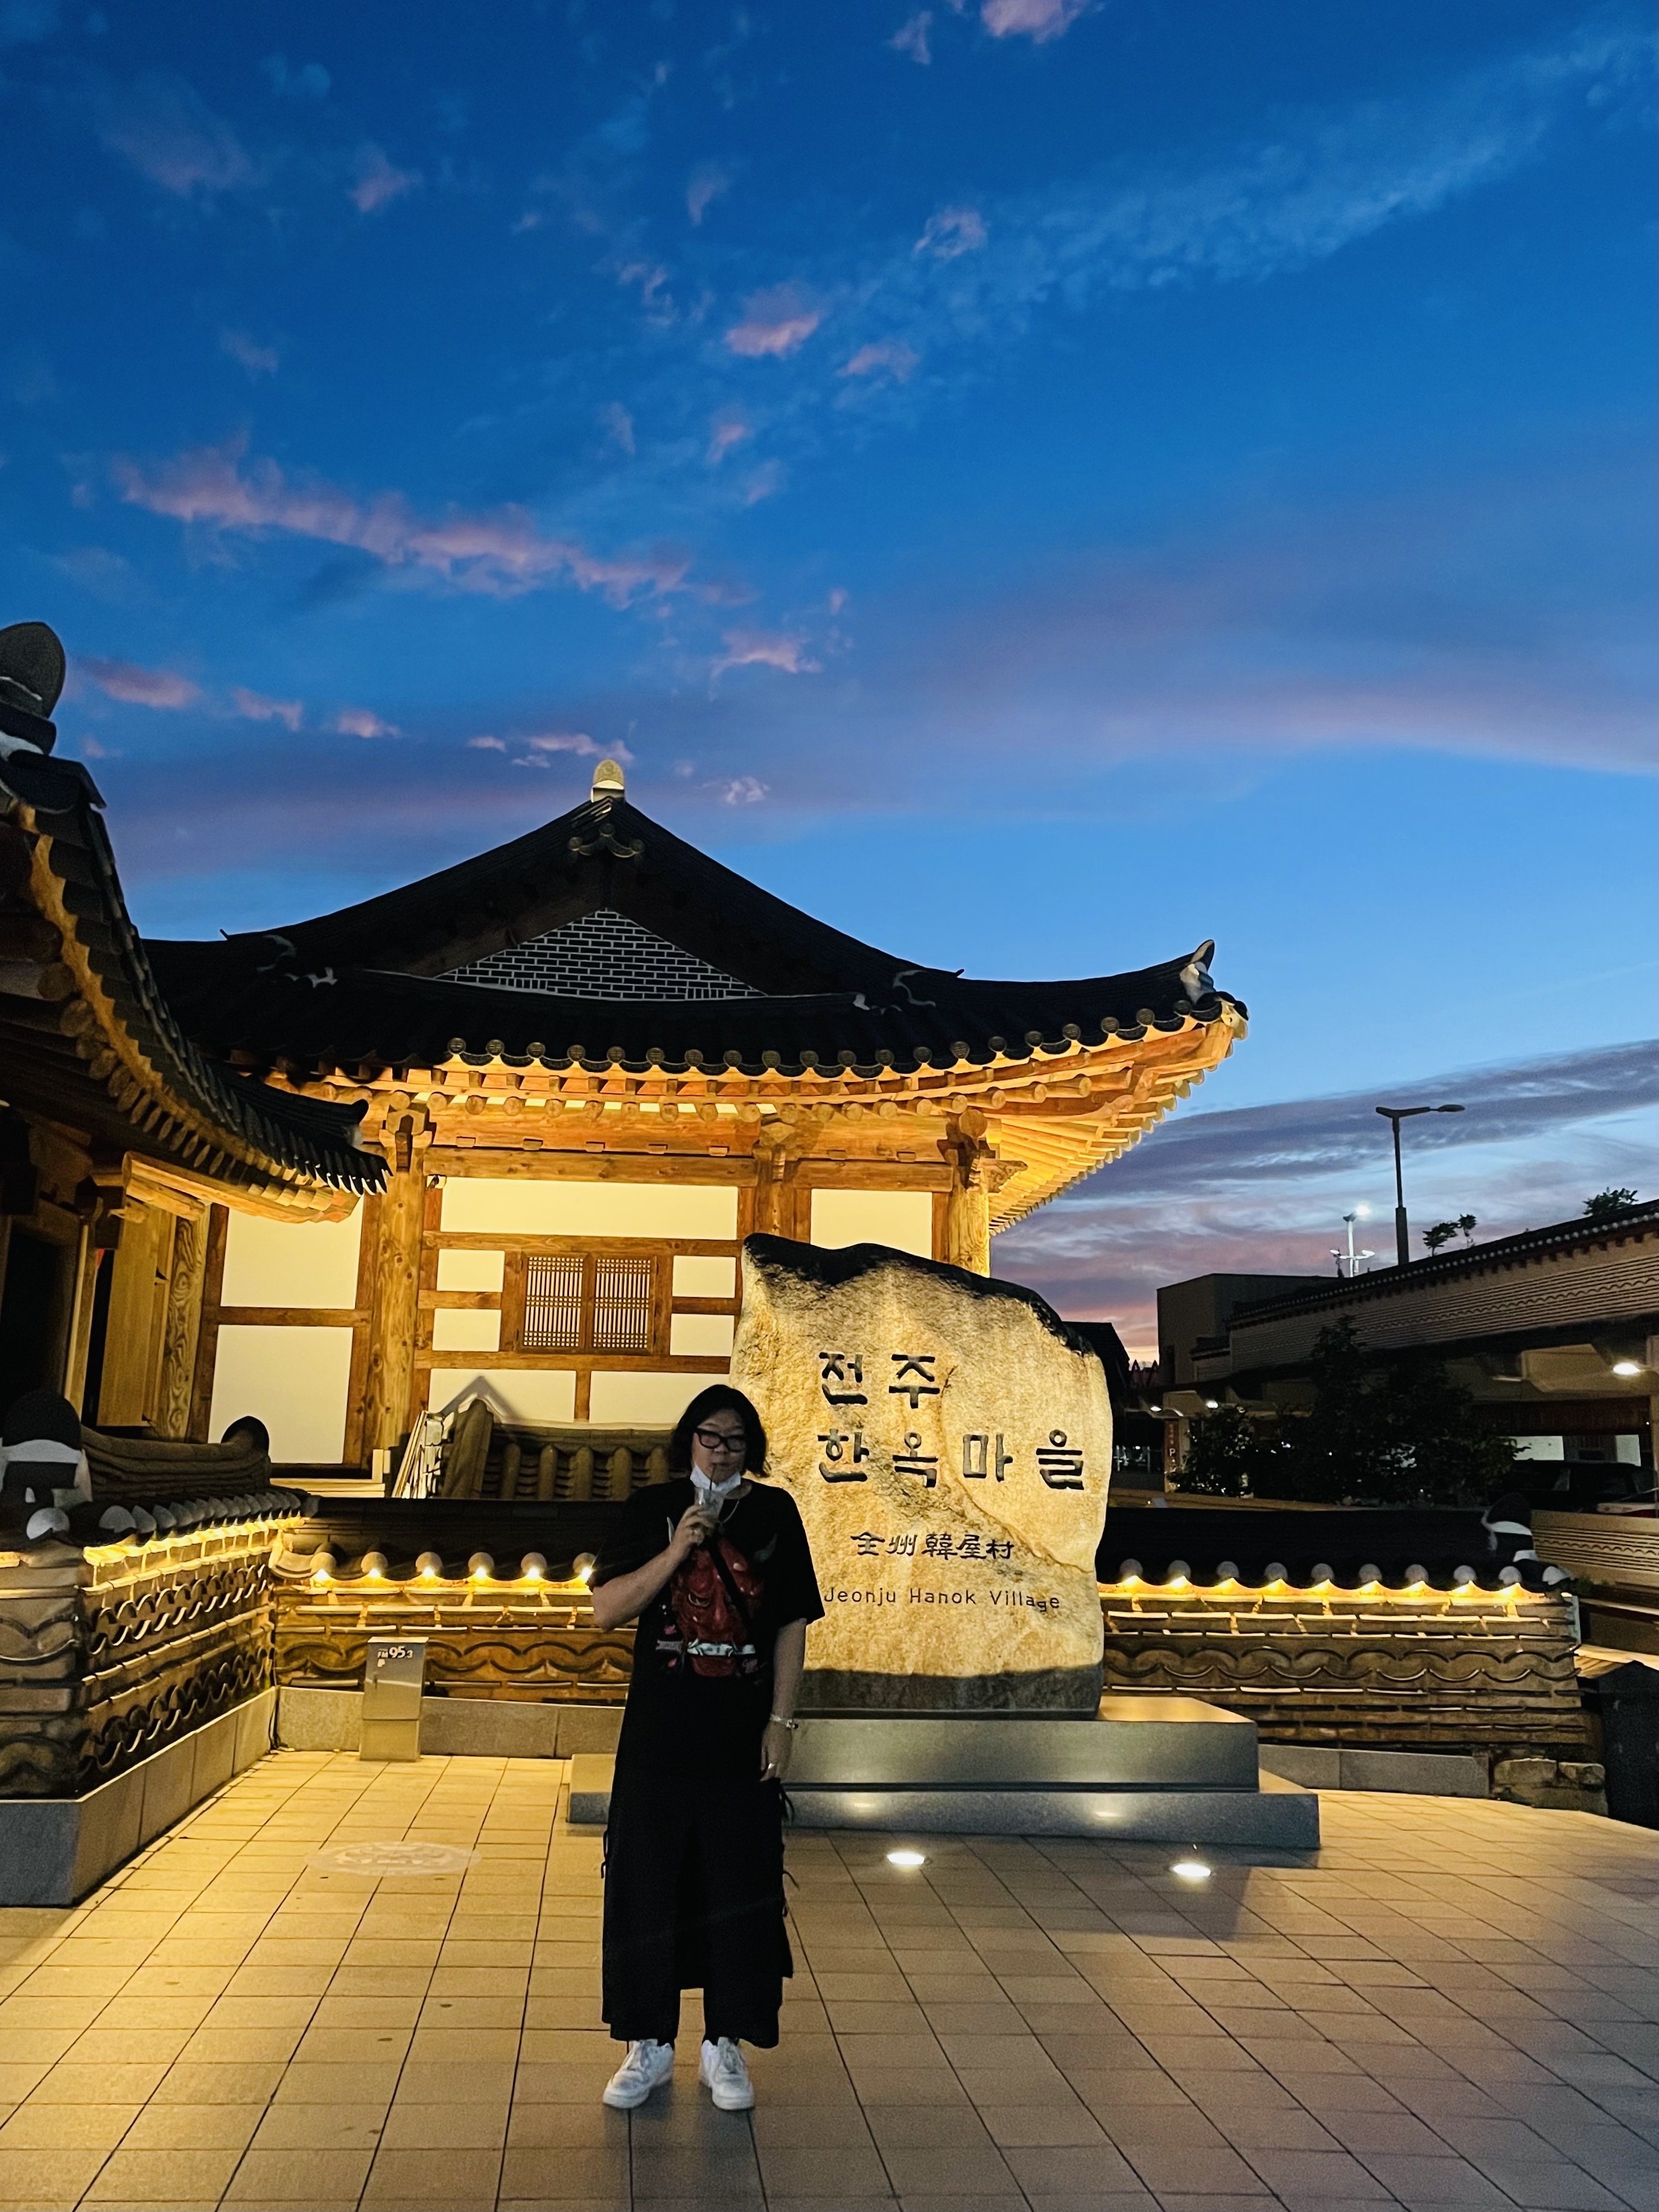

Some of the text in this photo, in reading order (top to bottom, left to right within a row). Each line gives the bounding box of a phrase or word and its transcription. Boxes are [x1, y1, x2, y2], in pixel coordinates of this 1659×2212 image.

[818, 1352, 940, 1409] 전주
[817, 1429, 1084, 1490] 한옥마을
[850, 1531, 1015, 1561] 全州韓屋村
[824, 1587, 1060, 1613] Jeonju Hanok Village
